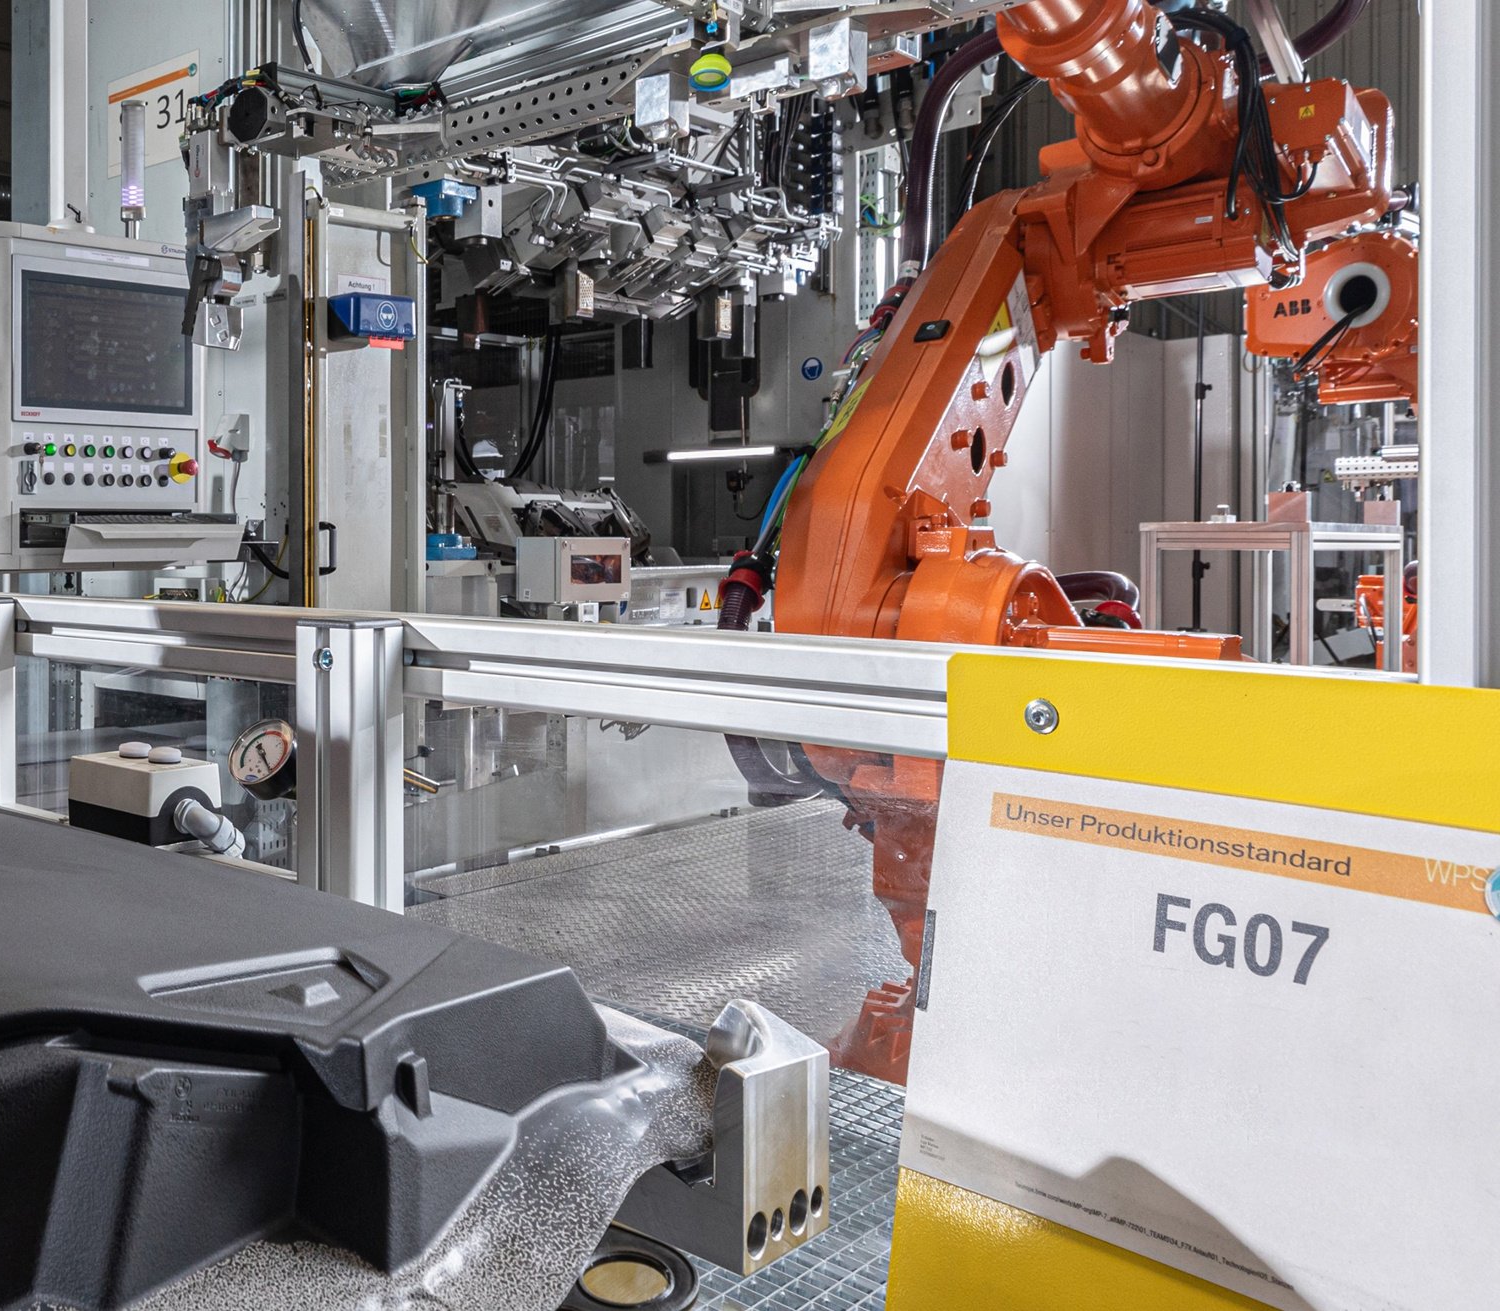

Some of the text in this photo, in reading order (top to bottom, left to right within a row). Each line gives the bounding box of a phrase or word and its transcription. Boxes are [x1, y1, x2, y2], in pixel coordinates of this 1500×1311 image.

[156, 88, 186, 129] 31
[348, 281, 372, 291] Achtung
[1273, 299, 1312, 318] ABB
[1005, 802, 1352, 877] Unser Produktionsstandard
[1423, 857, 1489, 892] WPS
[1152, 892, 1331, 986] FG07
